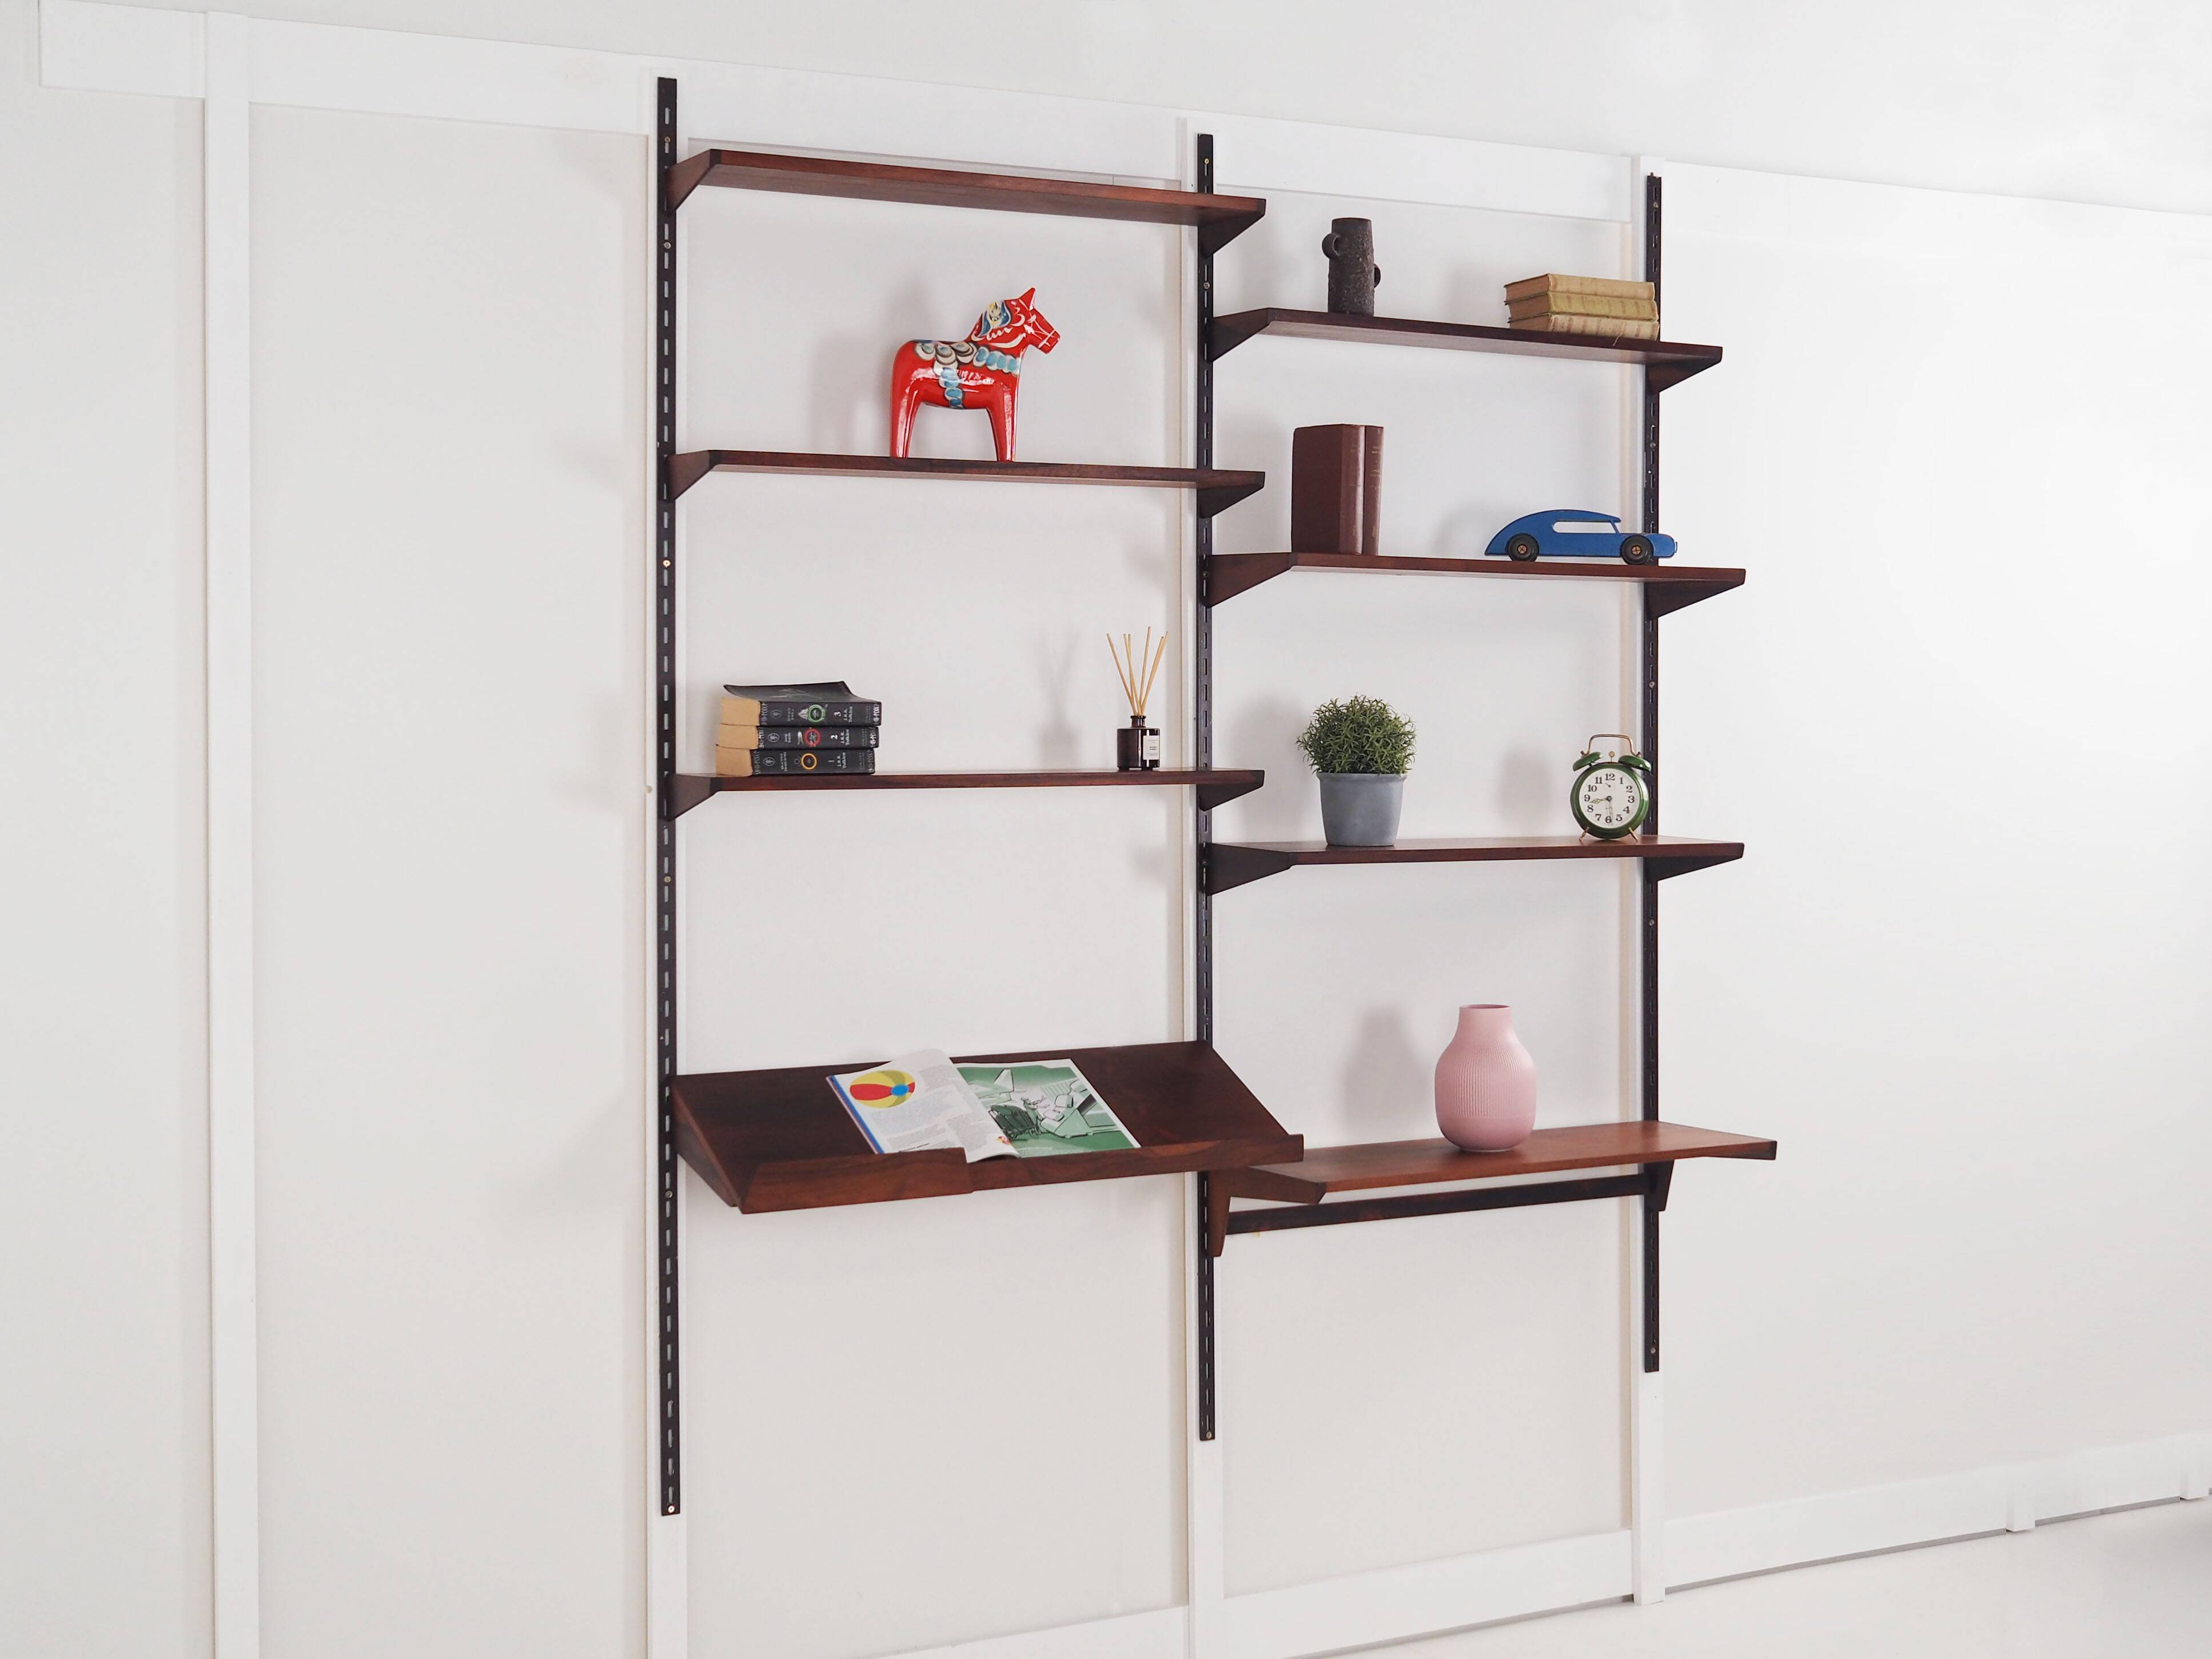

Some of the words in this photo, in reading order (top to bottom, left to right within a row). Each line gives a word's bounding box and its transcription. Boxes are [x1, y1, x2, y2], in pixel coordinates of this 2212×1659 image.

[1605, 773, 1615, 781] 12
[1628, 795, 1635, 803] 3
[1587, 804, 1594, 812] 8
[1623, 806, 1630, 814] 4
